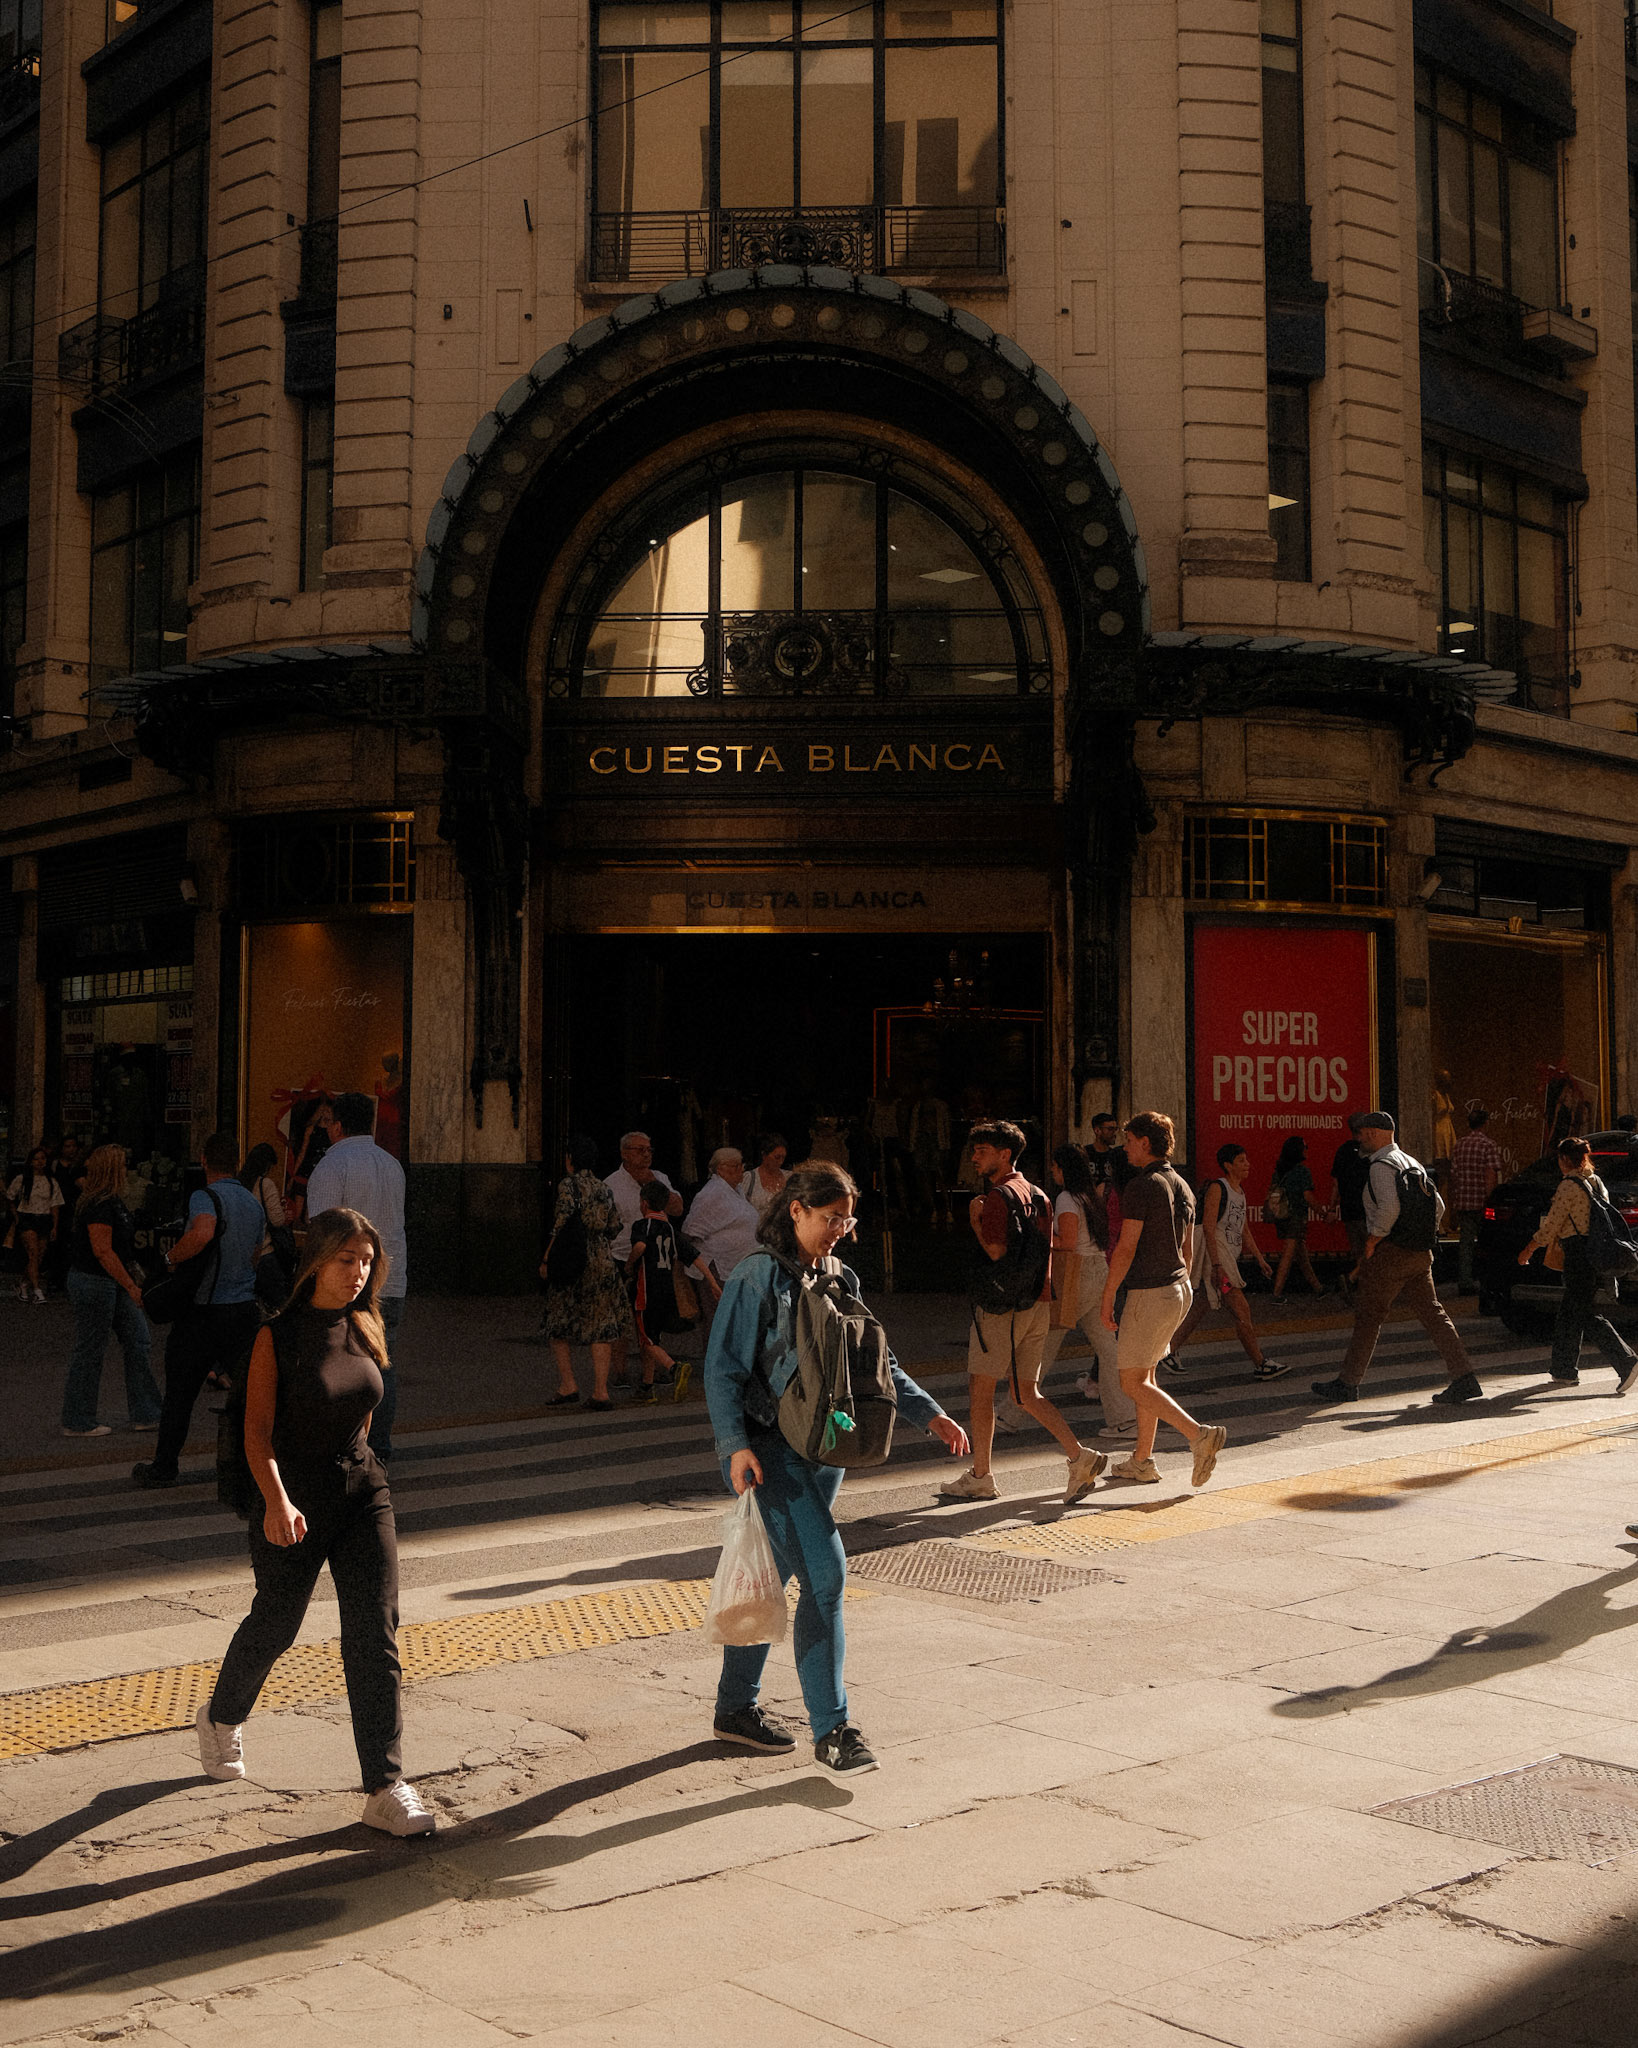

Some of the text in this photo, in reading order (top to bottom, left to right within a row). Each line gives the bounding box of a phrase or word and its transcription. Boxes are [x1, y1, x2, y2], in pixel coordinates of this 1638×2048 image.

[588, 743, 1006, 775] CUESTA BLANCA
[689, 891, 927, 909] CUESTA BLANCA
[331, 987, 382, 1013] Fiestas
[1242, 1010, 1319, 1046] SUPER
[1212, 1055, 1349, 1103] PRECIOS
[1219, 1114, 1343, 1129] OUTLET Y OPORTUNIDADES
